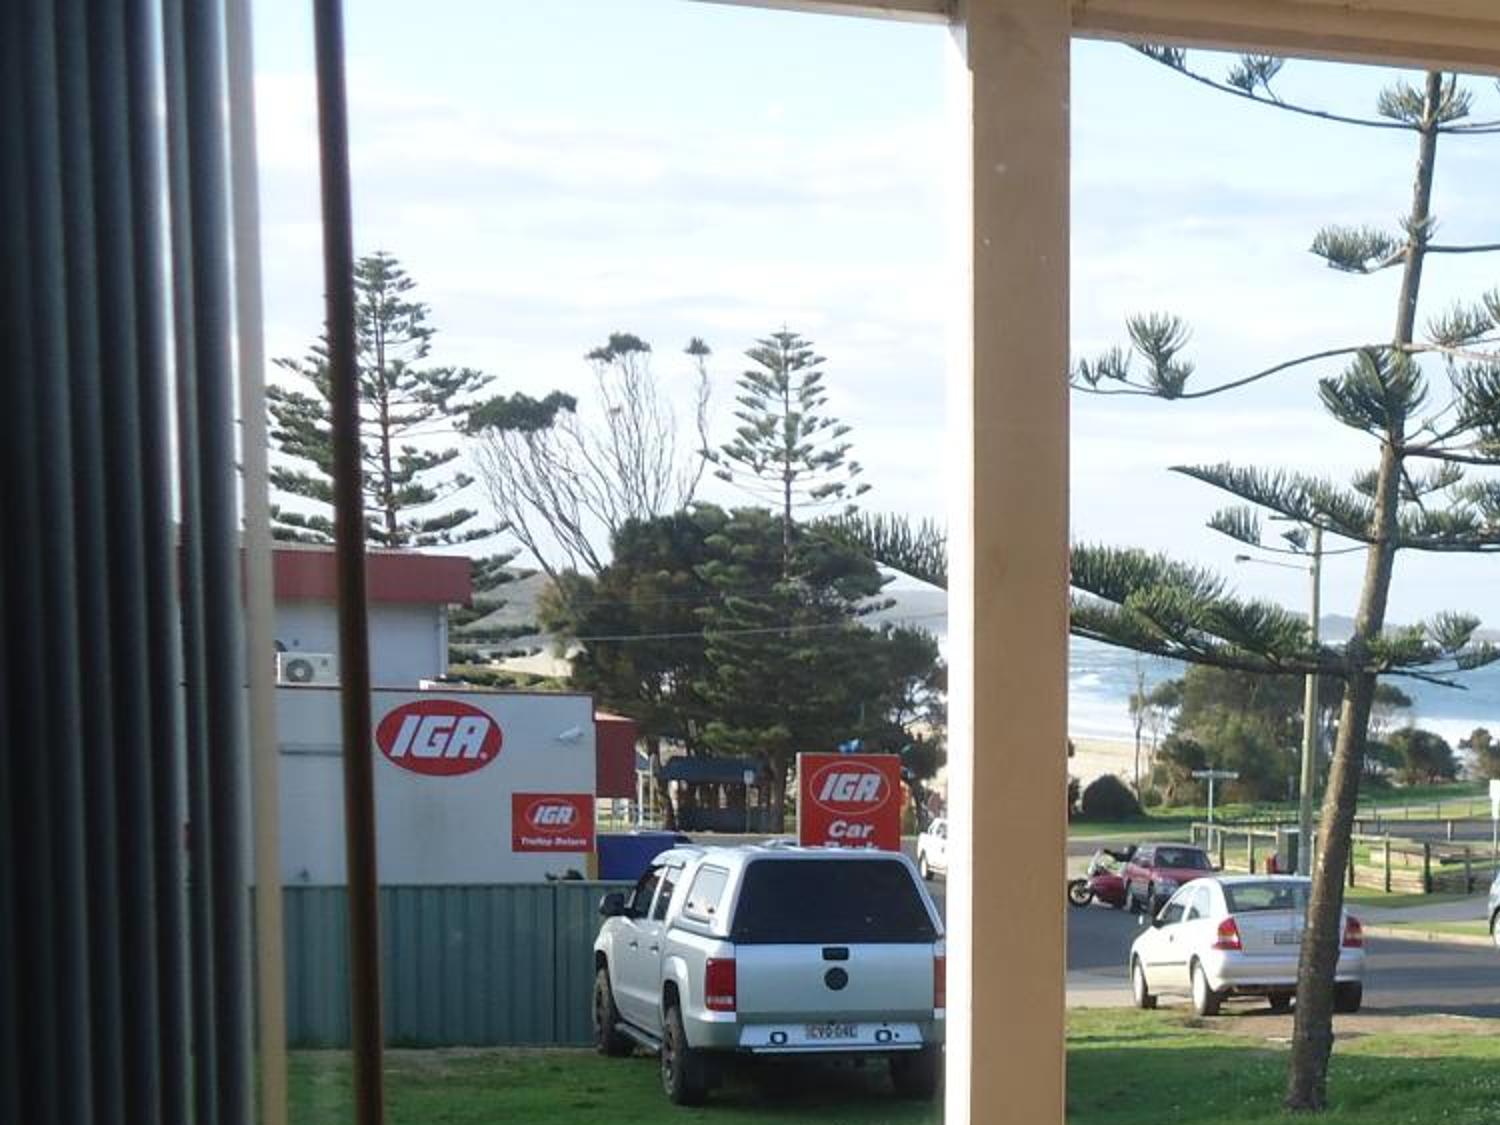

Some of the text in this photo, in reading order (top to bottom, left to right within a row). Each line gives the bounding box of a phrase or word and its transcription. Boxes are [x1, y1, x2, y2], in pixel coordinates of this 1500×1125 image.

[389, 714, 489, 758] IGA
[819, 772, 880, 802] IGA
[533, 804, 573, 824] IGA
[829, 820, 875, 839] Car
